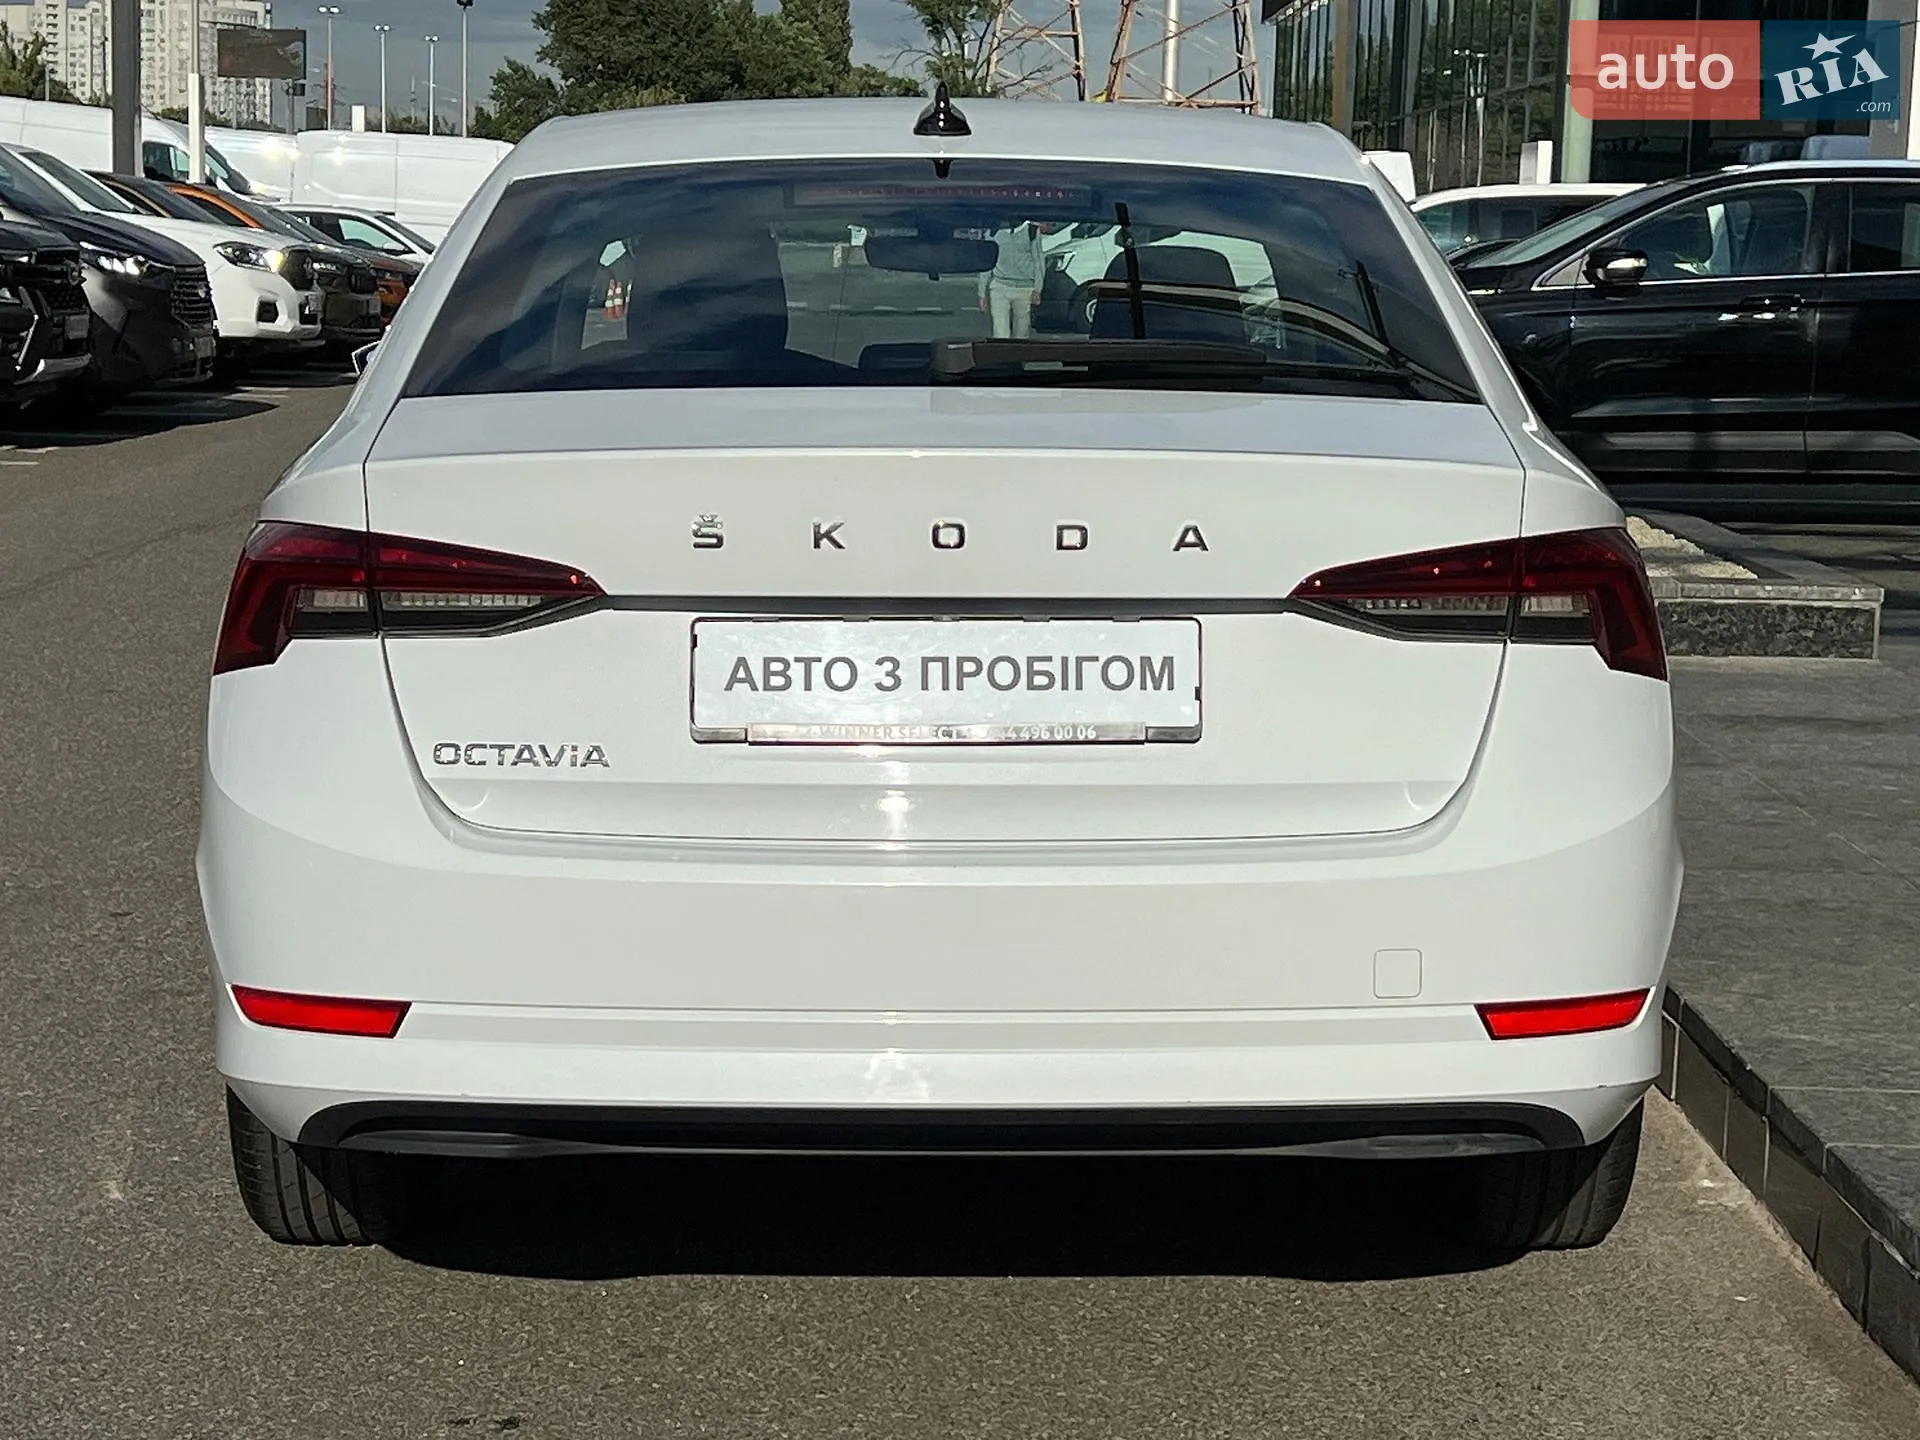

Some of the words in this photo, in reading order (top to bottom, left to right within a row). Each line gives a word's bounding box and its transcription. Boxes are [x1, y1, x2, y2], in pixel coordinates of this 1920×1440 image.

[692, 514, 1209, 552] ŠKODA
[725, 656, 857, 692] АВТО
[920, 655, 1175, 692] ПРОБІГОМ
[1020, 725, 1050, 740] 496
[1053, 725, 1073, 740] 00
[1076, 725, 1097, 740] 06
